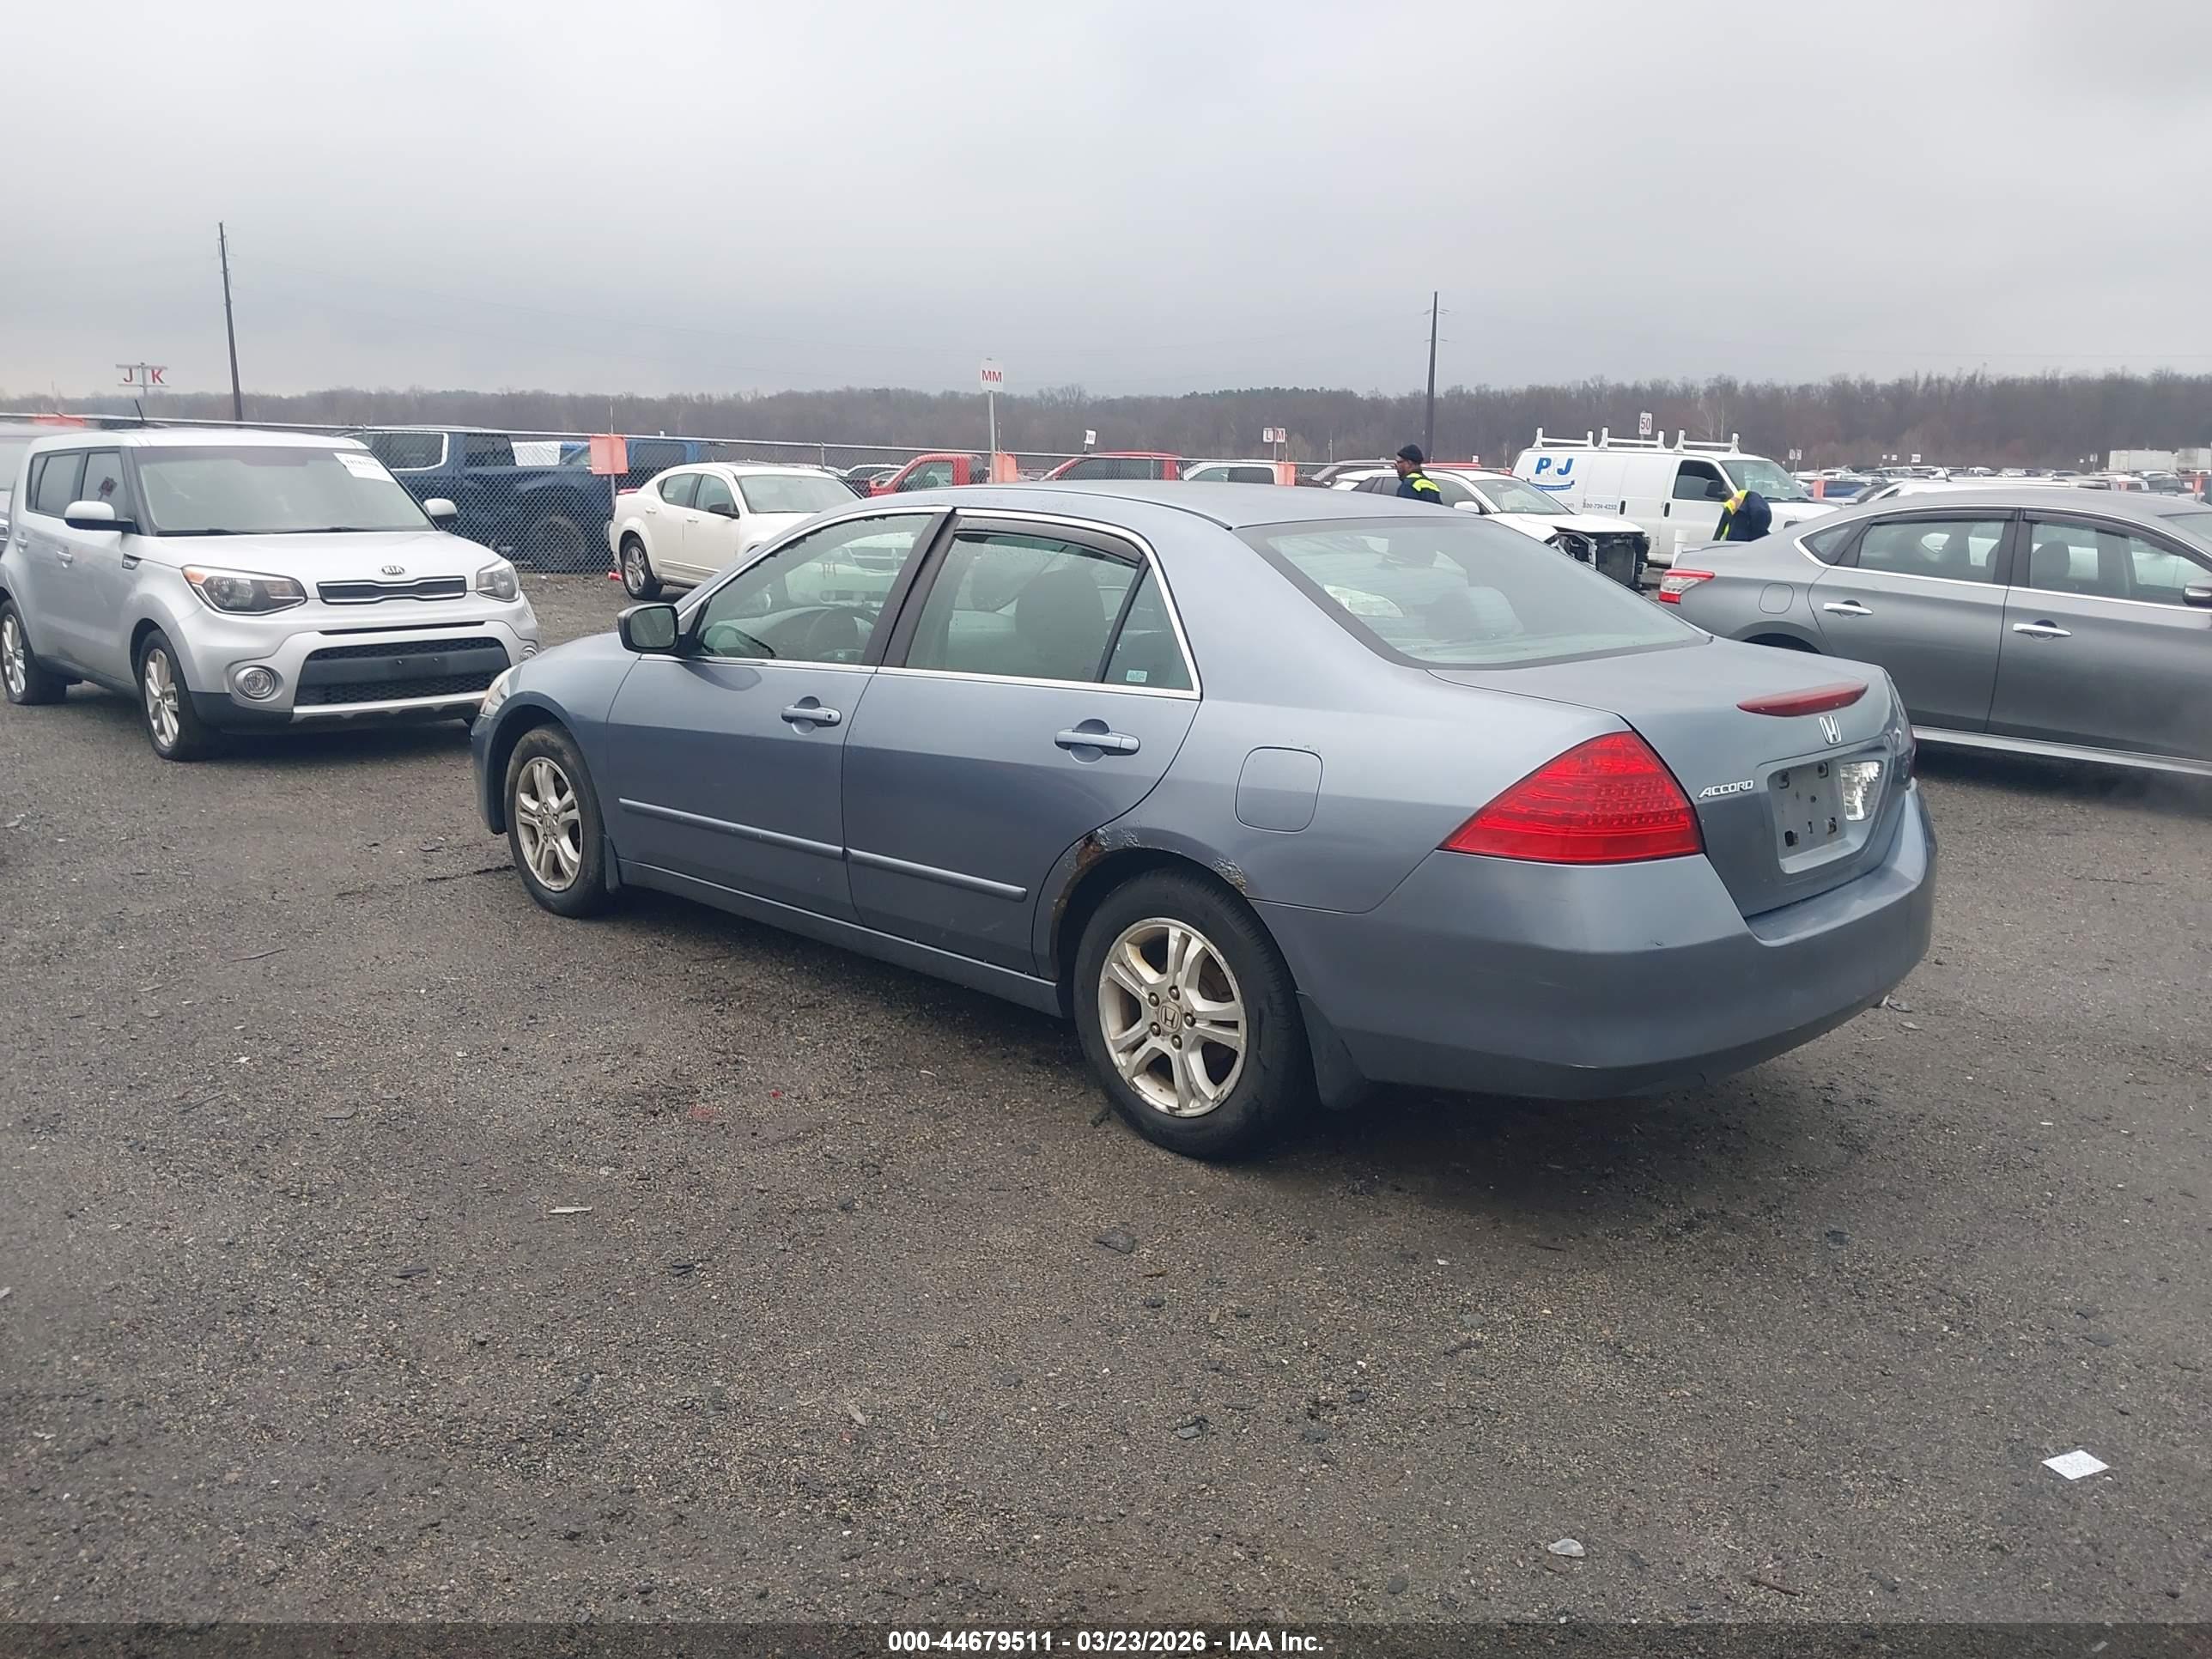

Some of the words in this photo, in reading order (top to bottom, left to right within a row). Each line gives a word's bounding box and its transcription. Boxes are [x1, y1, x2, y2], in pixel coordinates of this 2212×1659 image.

[123, 368, 133, 383] J
[151, 368, 165, 384] K
[981, 369, 1002, 383] MM
[1640, 417, 1651, 430] 50
[1275, 429, 1285, 441] M
[1698, 780, 1753, 799] ACCORD
